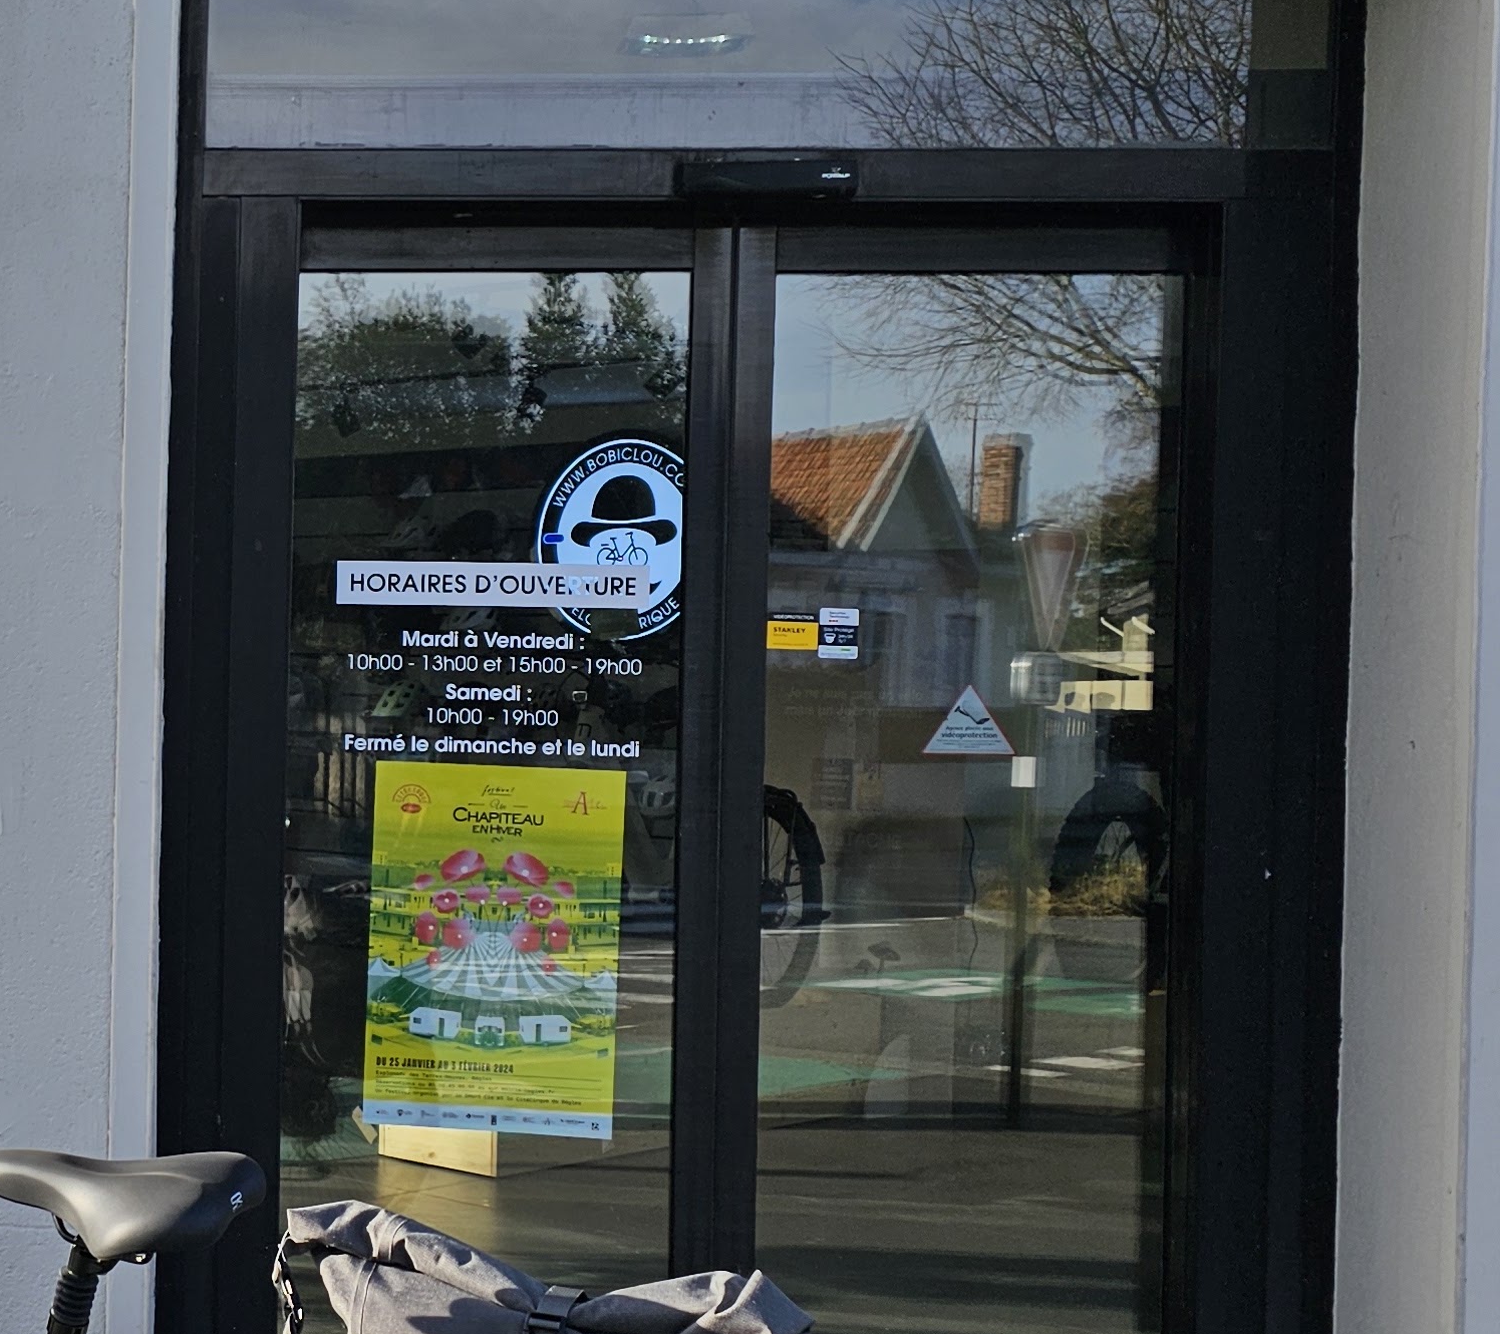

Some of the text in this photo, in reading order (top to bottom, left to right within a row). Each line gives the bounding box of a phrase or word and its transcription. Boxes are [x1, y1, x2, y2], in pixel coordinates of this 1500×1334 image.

[349, 572, 467, 595] HORAIRES
[401, 629, 459, 649] Mardi
[466, 630, 479, 649] à
[484, 631, 574, 651] Vendredi
[773, 626, 806, 634] STANLEY
[347, 653, 403, 672] 10h00
[422, 654, 479, 673] 13h00
[483, 656, 502, 673] et
[510, 656, 566, 675] 15h00
[585, 657, 643, 676] 19h00
[444, 683, 522, 702] Samedi
[426, 706, 483, 725] 10h00
[502, 708, 559, 727] 19h00
[941, 731, 998, 739] vidéoprotection
[343, 733, 641, 759] Fermé le dimanche et le lundi
[453, 806, 544, 826] CHAPITEAU
[472, 825, 523, 837] EN HIVER
[376, 1056, 387, 1066] DU
[389, 1057, 400, 1067] 25
[401, 1058, 435, 1069] JANVIER
[437, 1060, 449, 1070] AU
[458, 1060, 491, 1072] FÉVRIER
[494, 1063, 514, 1073] 2024
